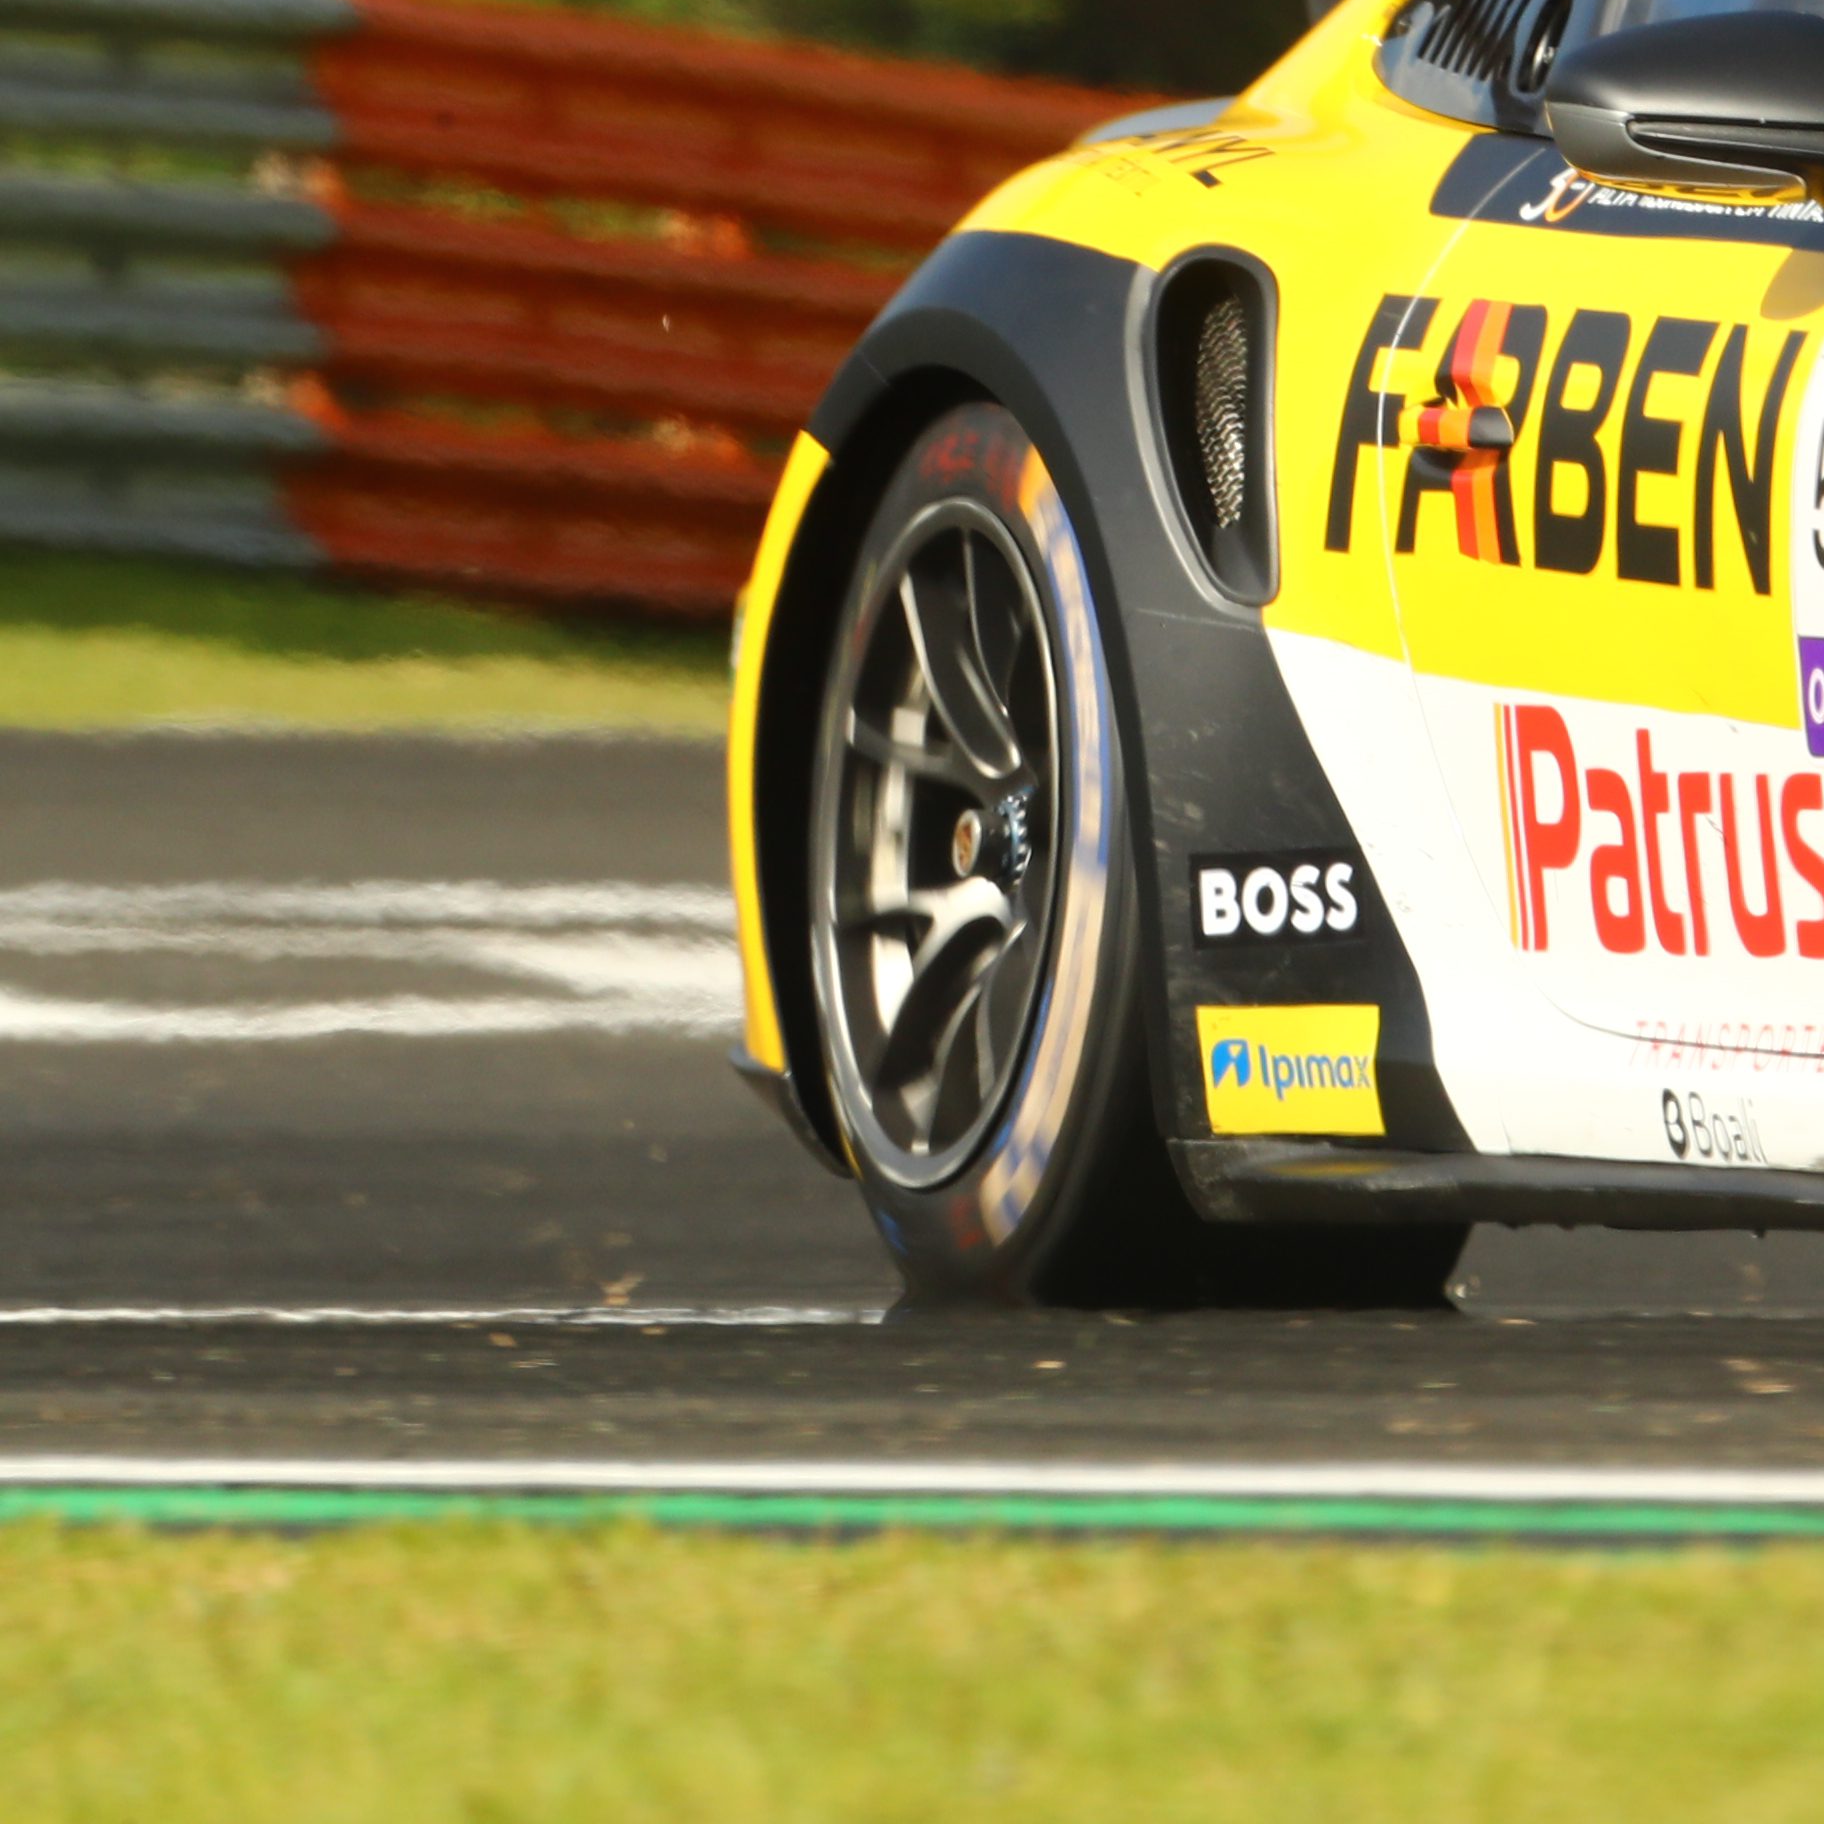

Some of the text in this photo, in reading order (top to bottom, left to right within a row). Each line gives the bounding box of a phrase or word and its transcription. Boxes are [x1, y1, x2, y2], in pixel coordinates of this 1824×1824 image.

[1323, 293, 1808, 597] FARBEN
[1200, 862, 1358, 937] BOSS
[1688, 1090, 1768, 1164] Boali
